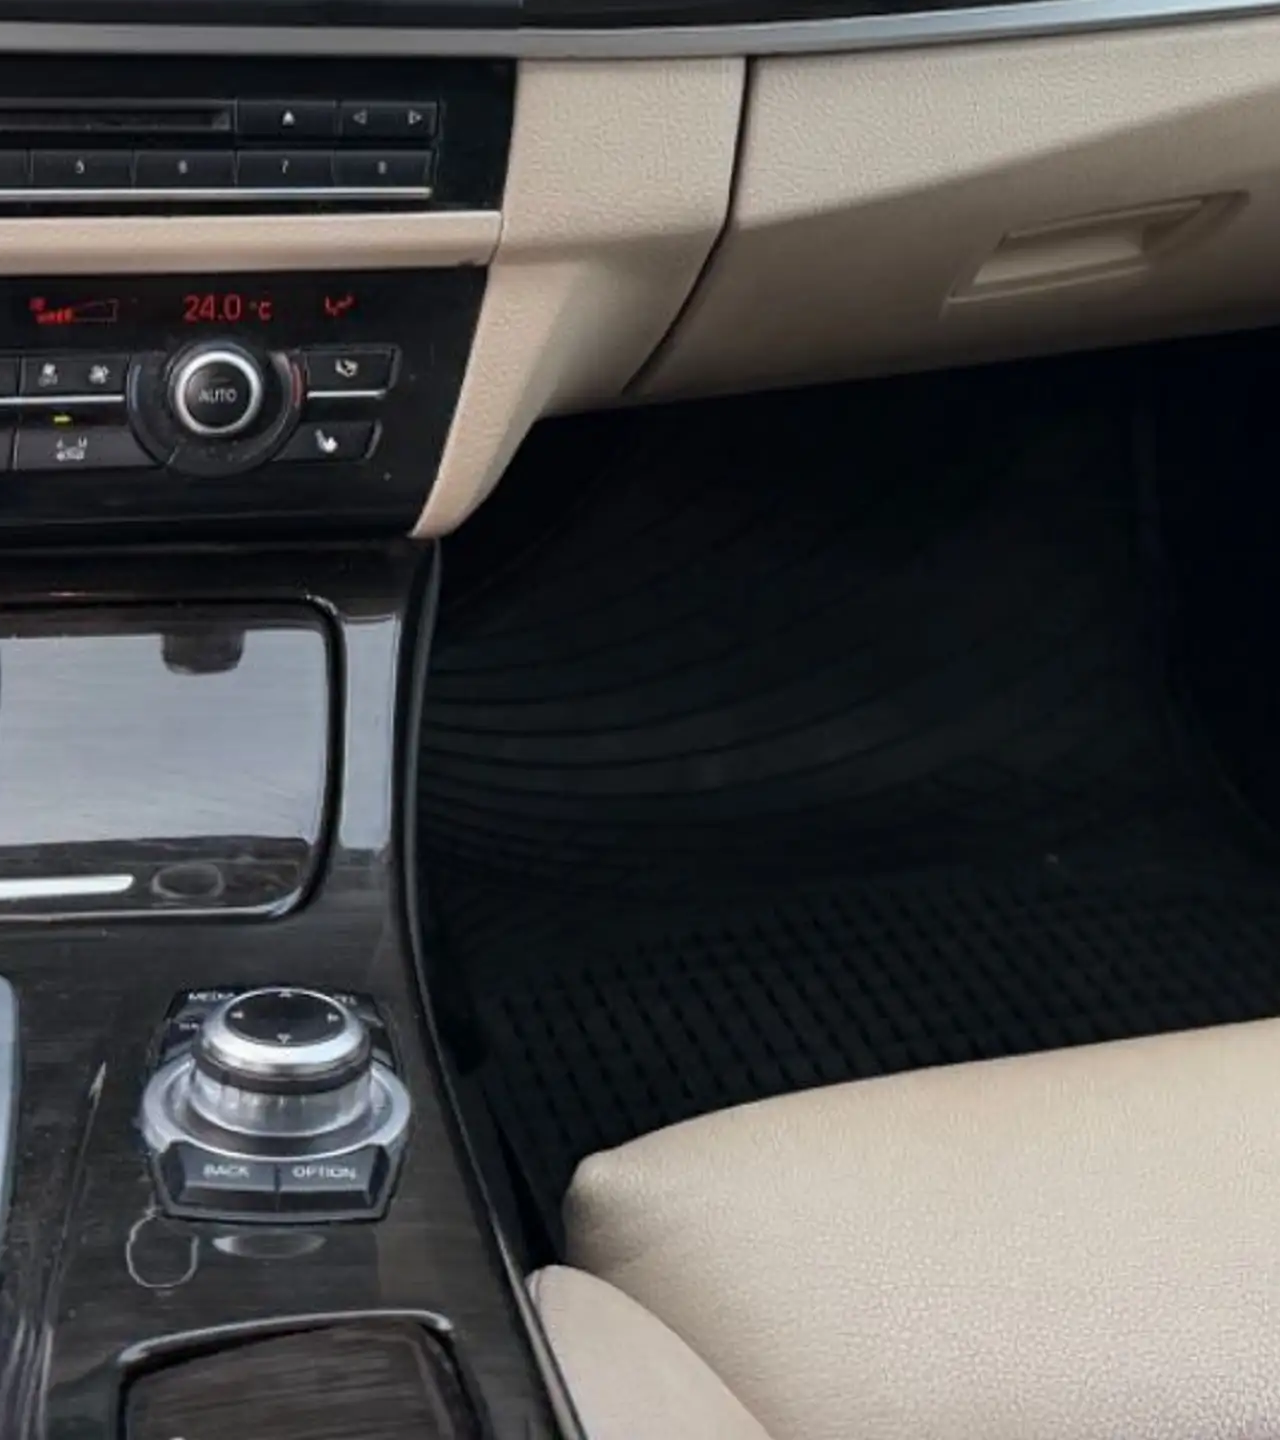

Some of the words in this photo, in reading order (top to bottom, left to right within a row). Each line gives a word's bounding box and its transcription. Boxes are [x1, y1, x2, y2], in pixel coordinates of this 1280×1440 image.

[184, 293, 242, 321] 24.0
[197, 387, 238, 404] AUTO
[203, 1164, 250, 1177] BACK
[292, 1165, 357, 1180] OPTION
